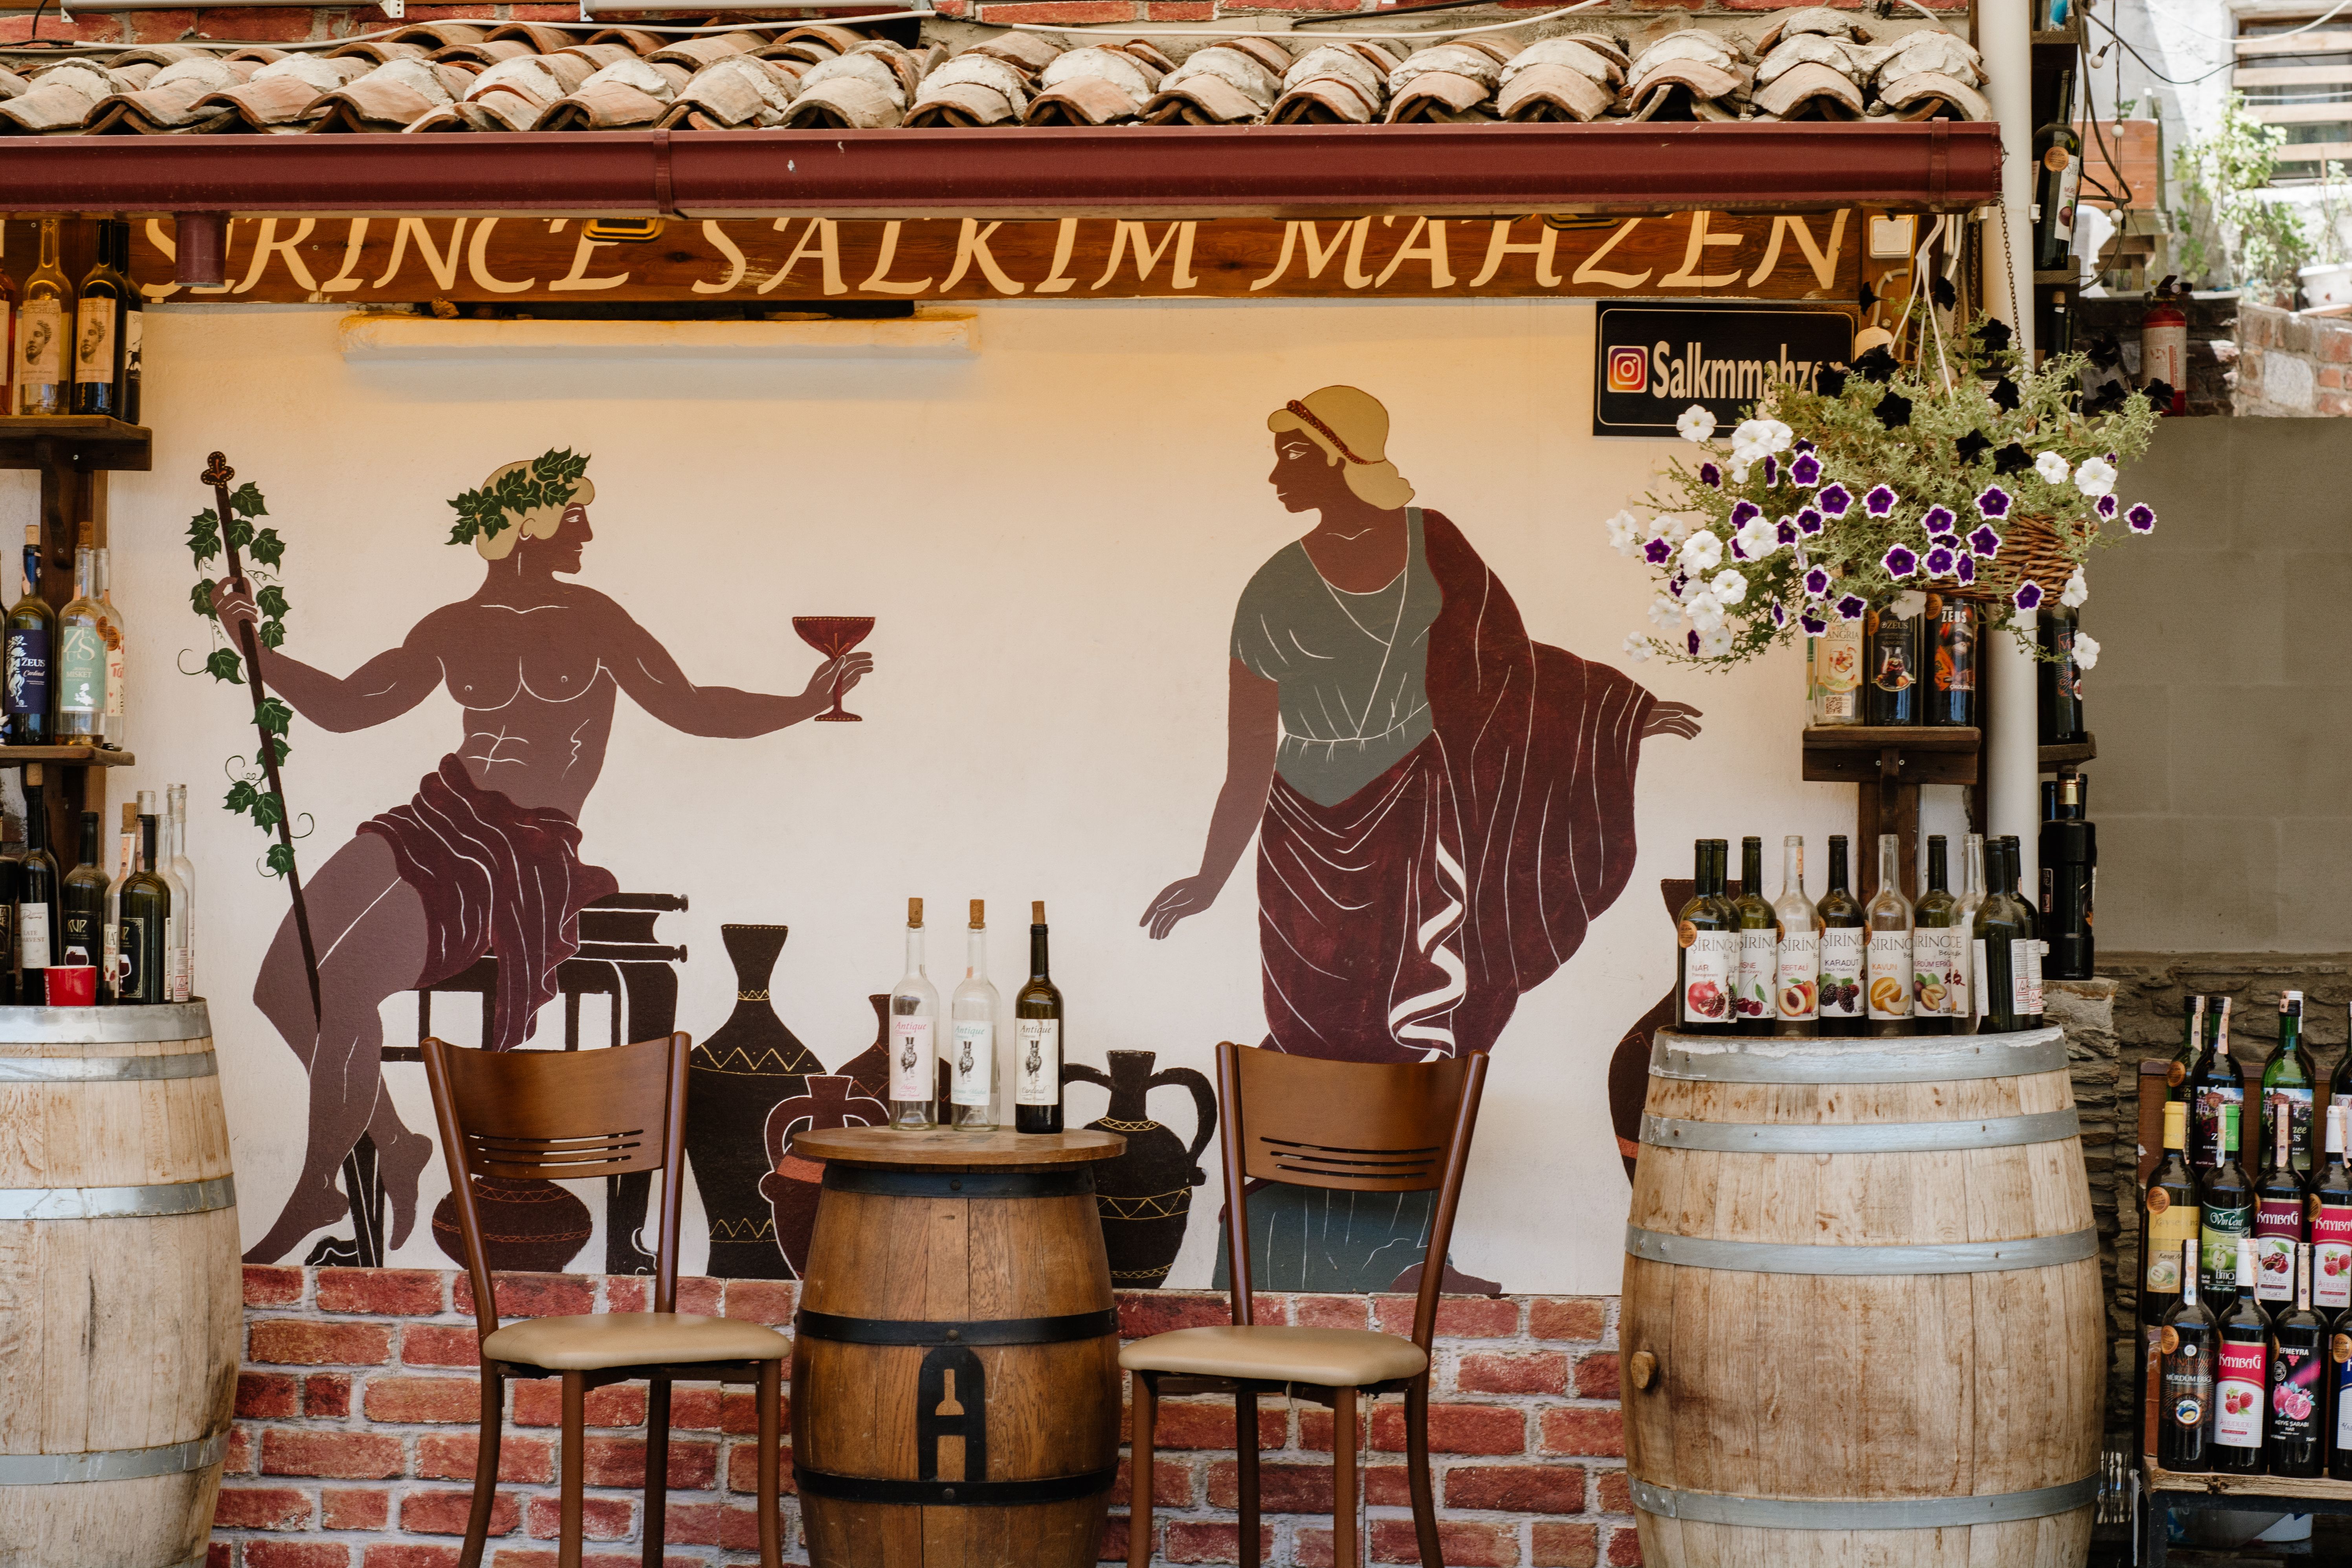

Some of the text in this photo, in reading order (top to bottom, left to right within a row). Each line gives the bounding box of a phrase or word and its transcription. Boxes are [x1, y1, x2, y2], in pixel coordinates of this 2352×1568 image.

[691, 217, 1198, 295] SALKIM
[1249, 208, 1851, 292] MAHZEN
[1941, 611, 1967, 623] ZEUS
[1886, 621, 1909, 629] ZEUS
[1825, 630, 1860, 640] ANGRIA
[21, 658, 46, 667] ZEUS
[895, 1022, 927, 1032] Antique
[955, 1026, 985, 1037] Antique
[1020, 1025, 1051, 1036] Antique
[1022, 1085, 1050, 1095] Cardinal
[2315, 1217, 2352, 1231] KAYIBA
